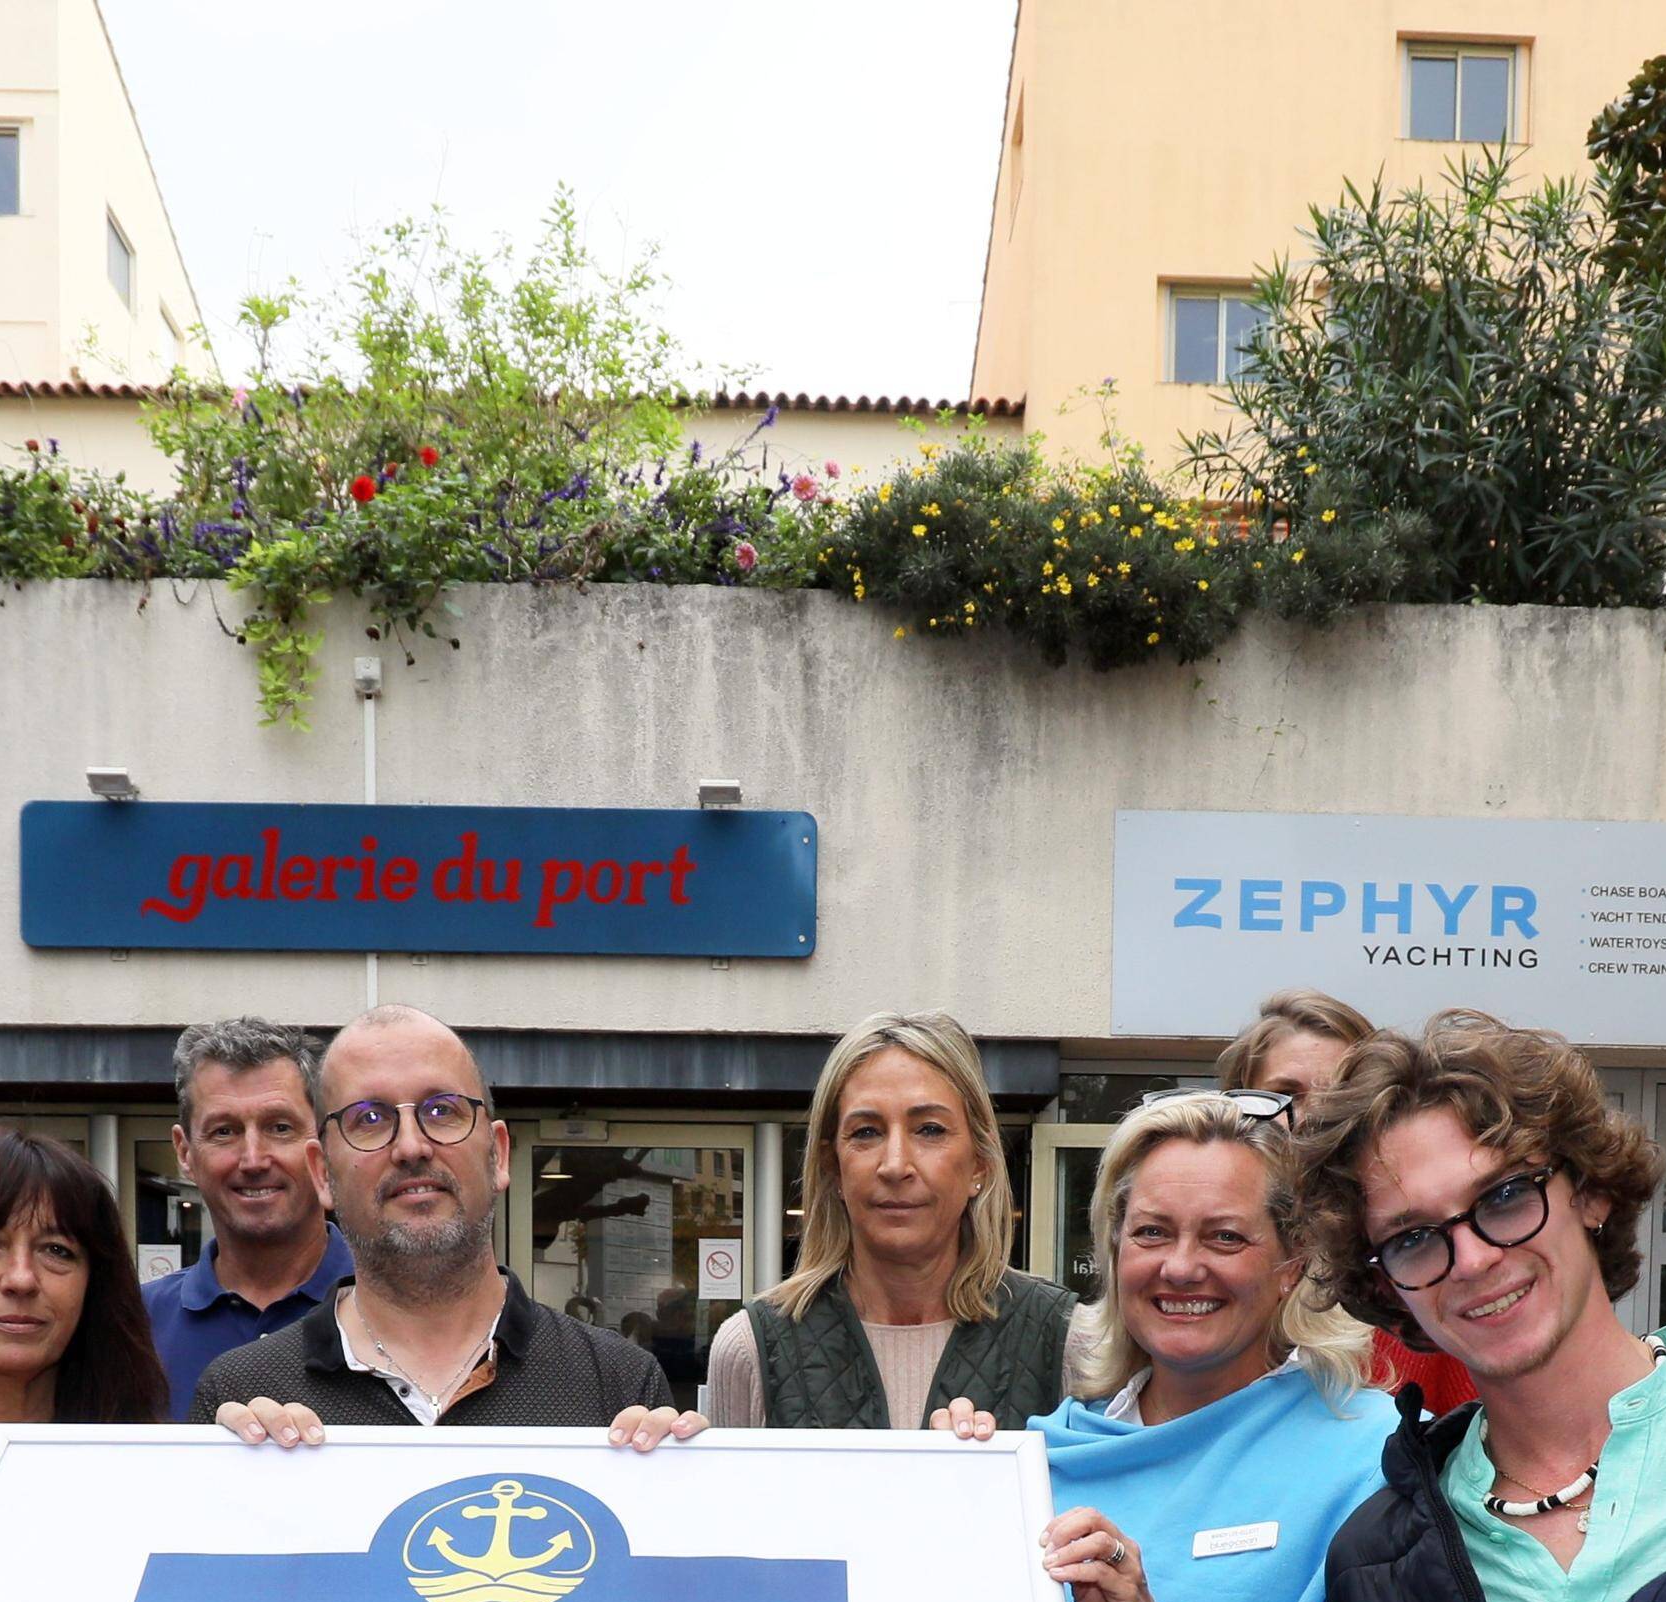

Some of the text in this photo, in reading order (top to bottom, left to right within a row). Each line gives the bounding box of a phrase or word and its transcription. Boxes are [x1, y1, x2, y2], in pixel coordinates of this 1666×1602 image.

[140, 827, 697, 928] galerie du port
[1590, 885, 1635, 898] CHASE
[1173, 877, 1540, 940] ZEPHYR
[1590, 911, 1634, 923] YACHT
[1362, 945, 1539, 970] YACHTING
[1588, 962, 1629, 974] CREW
